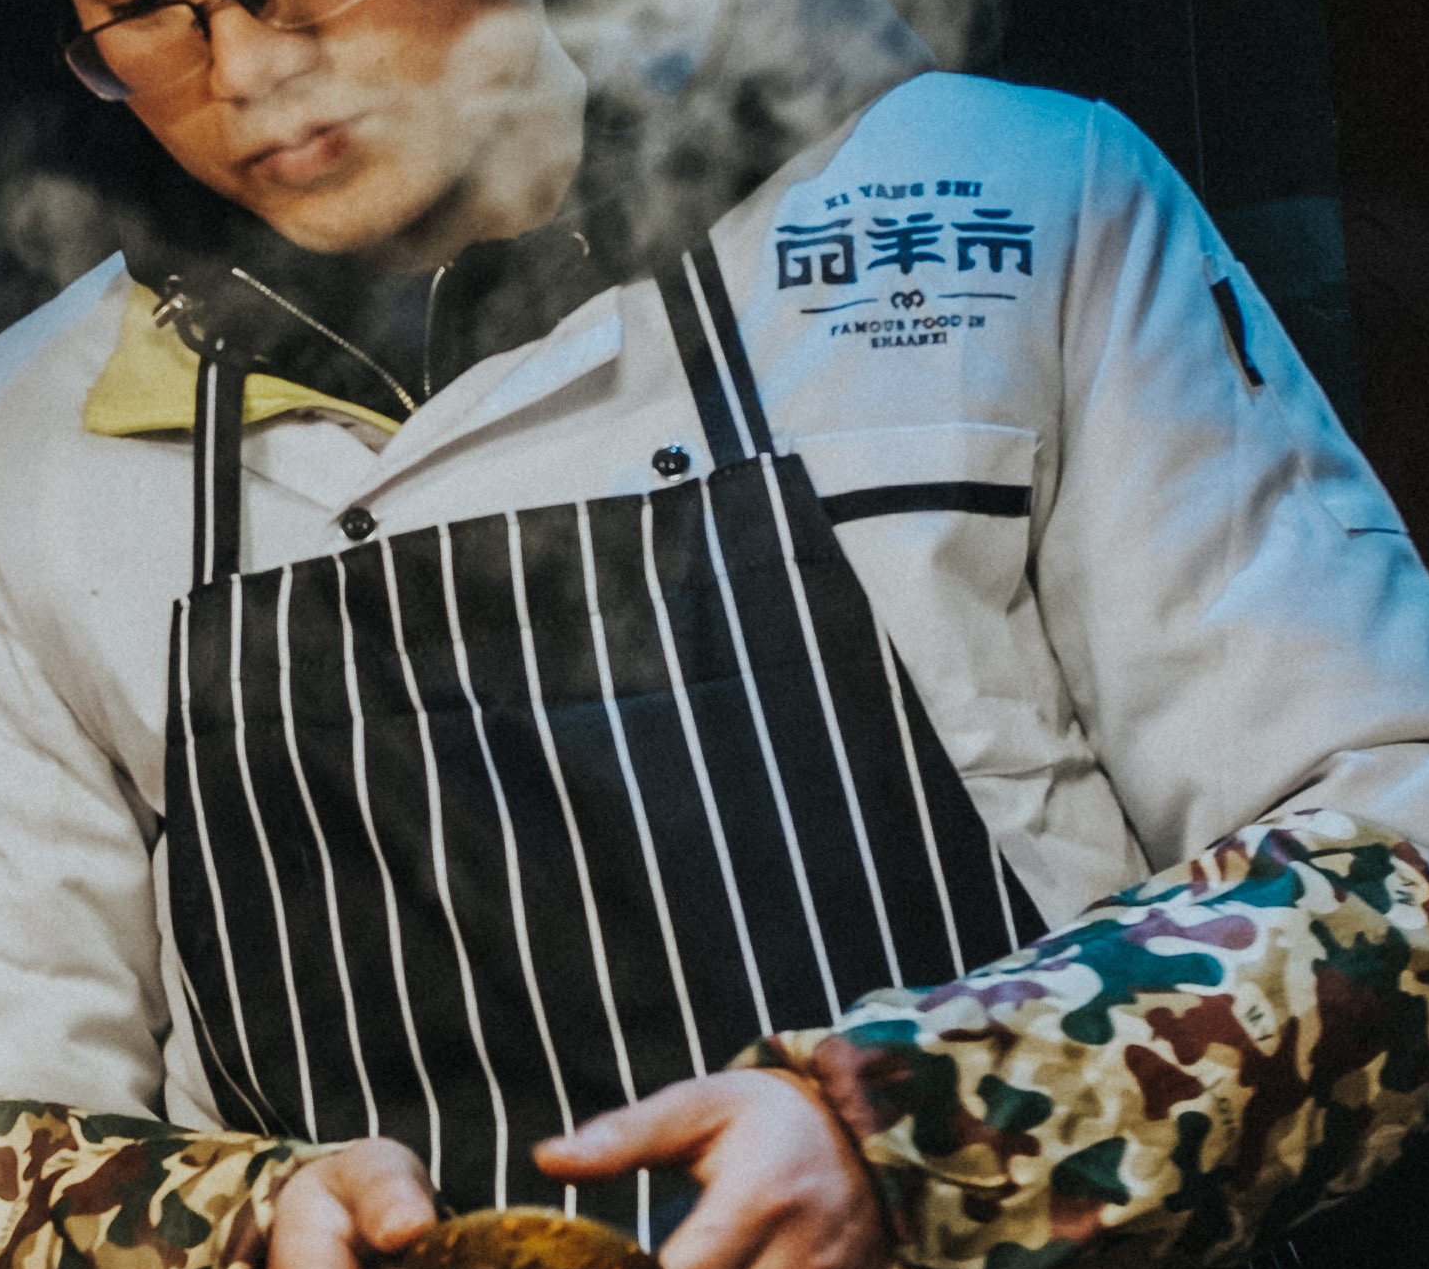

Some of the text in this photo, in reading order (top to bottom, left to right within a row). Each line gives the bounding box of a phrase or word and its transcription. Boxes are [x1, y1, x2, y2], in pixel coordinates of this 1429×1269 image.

[858, 182, 925, 200] YANG
[830, 319, 906, 336] FAMOUS
[912, 314, 963, 330] FOOD
